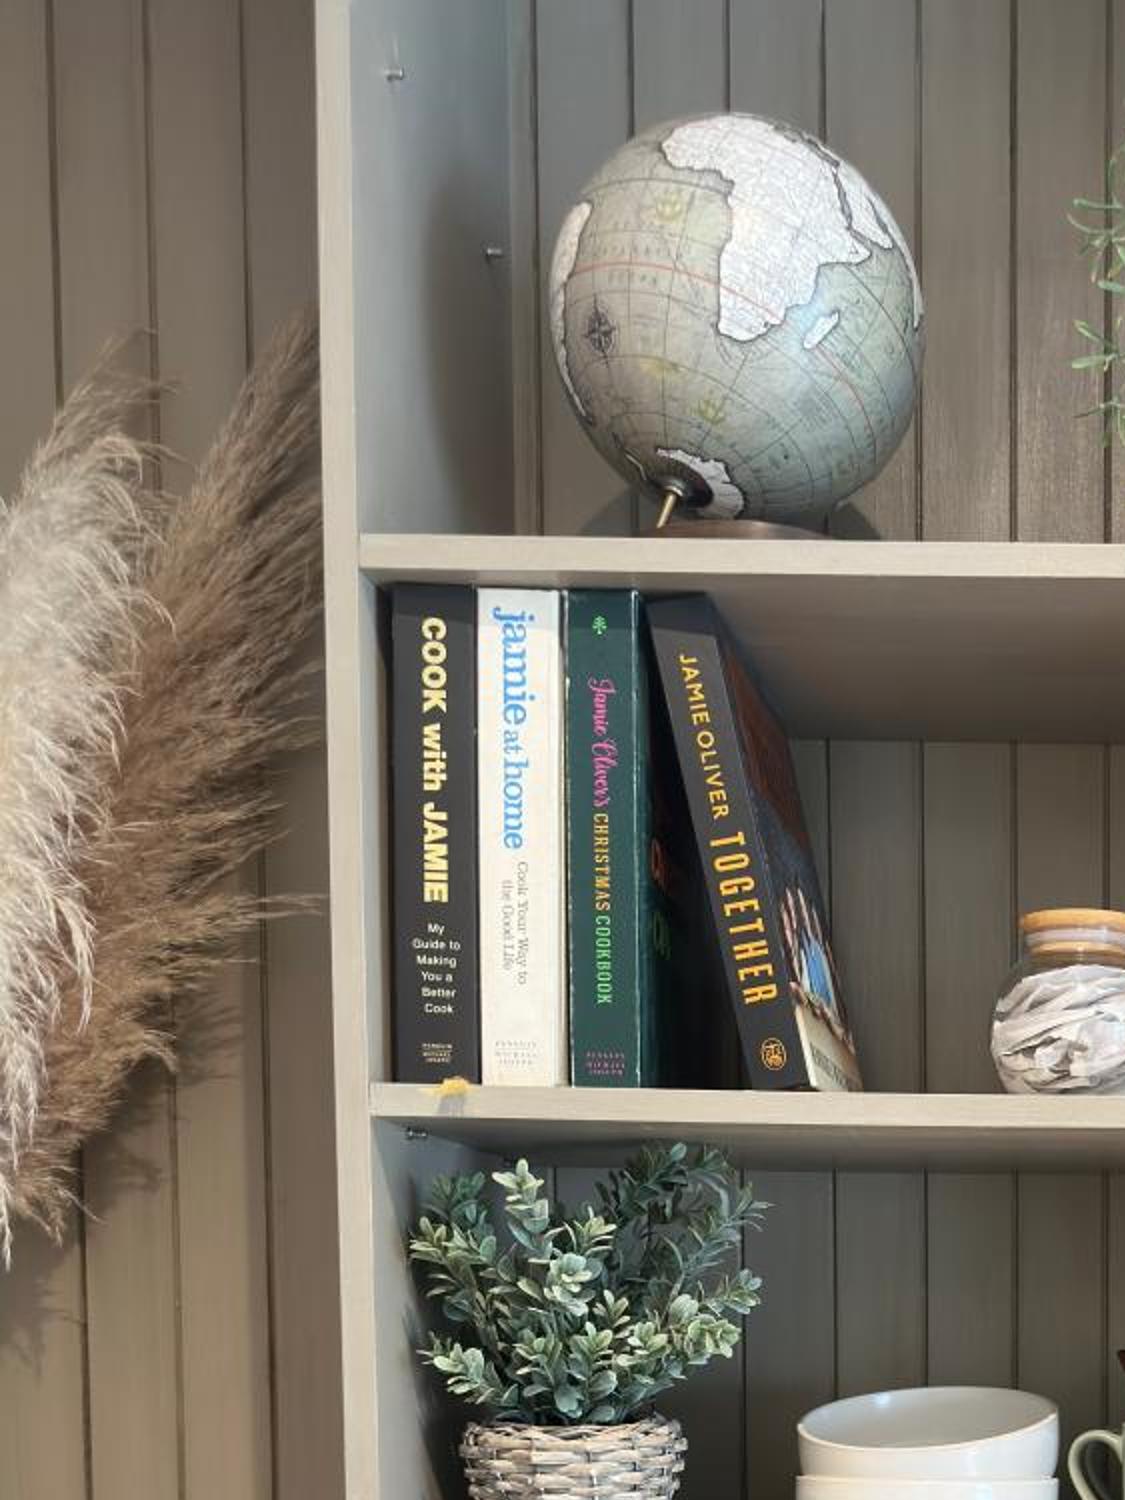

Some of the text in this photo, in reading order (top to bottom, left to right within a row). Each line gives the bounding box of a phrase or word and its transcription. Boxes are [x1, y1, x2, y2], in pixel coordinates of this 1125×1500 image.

[587, 677, 616, 736] Jamie
[492, 606, 536, 849] jamie at home
[421, 617, 449, 903] COOK with JAMIE
[679, 653, 778, 1005] JAMIE OLIVER TOGETHER
[593, 813, 611, 912] CHRISTMAS
[427, 923, 446, 936] My
[502, 905, 515, 940] Good
[515, 861, 529, 985] Cook Your Way to
[412, 938, 461, 950] Guide to
[503, 944, 515, 971] Life
[594, 915, 612, 1004] COOKBOOK
[416, 955, 457, 969] Making
[421, 971, 453, 982] You a
[421, 987, 457, 998] Better
[424, 1003, 454, 1013] Cook
